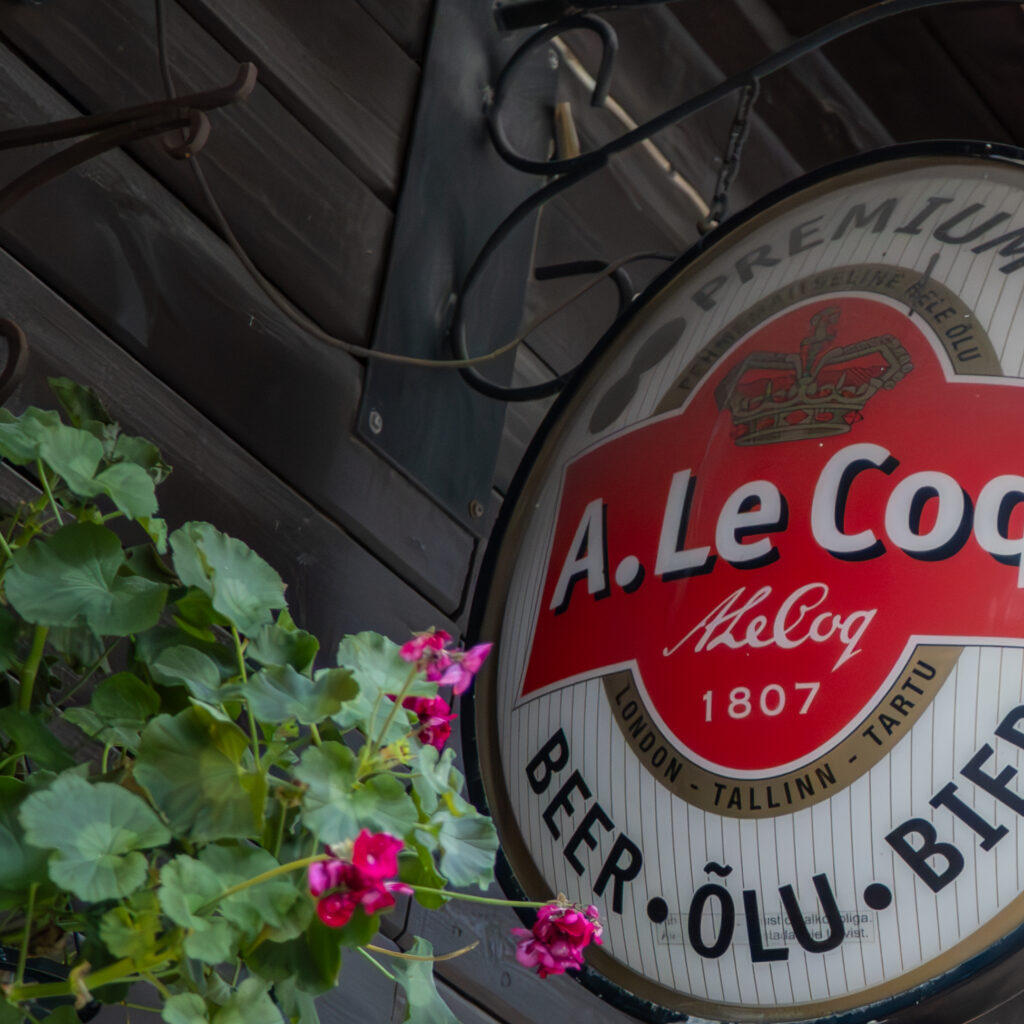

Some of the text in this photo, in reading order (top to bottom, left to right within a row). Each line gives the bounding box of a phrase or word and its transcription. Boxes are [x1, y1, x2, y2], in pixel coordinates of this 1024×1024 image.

[945, 323, 981, 362] ÕLU
[616, 659, 938, 811] LONDON TALLINN TARTU
[702, 682, 821, 723] 1807
[525, 727, 644, 915] BEER
[687, 861, 846, 963] ÕLU
